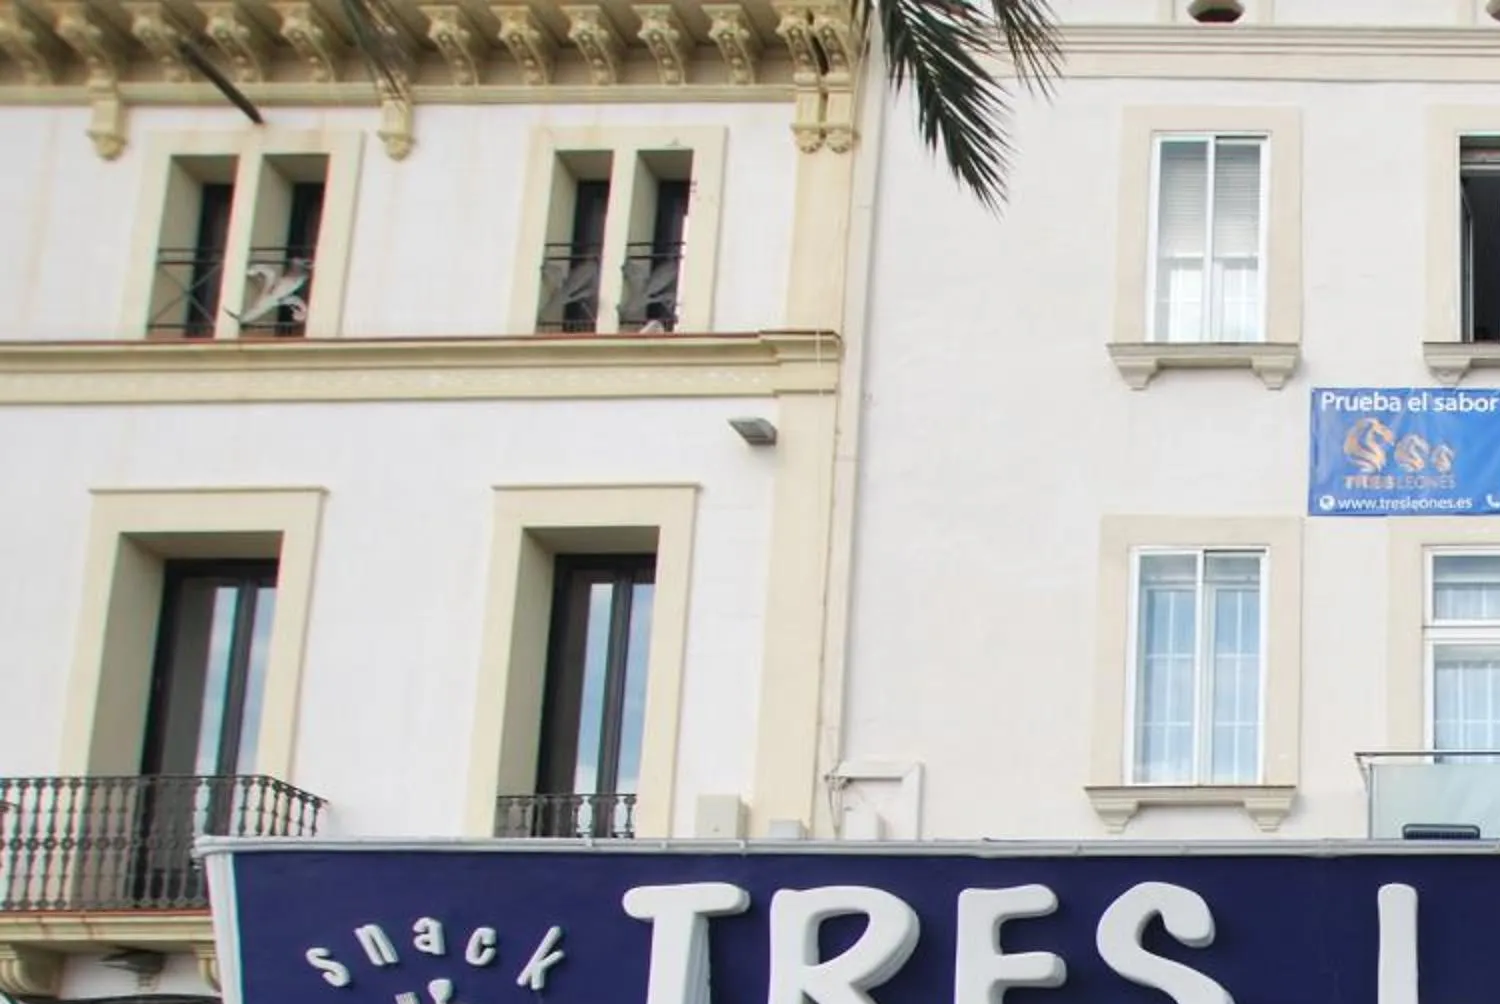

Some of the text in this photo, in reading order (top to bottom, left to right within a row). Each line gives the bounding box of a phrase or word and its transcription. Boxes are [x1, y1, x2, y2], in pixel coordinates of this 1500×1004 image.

[1321, 392, 1400, 412] Prueba
[1407, 391, 1428, 412] el
[1434, 392, 1499, 413] sabor
[1337, 495, 1473, 510] www.tresleones.es
[305, 916, 566, 990] snack
